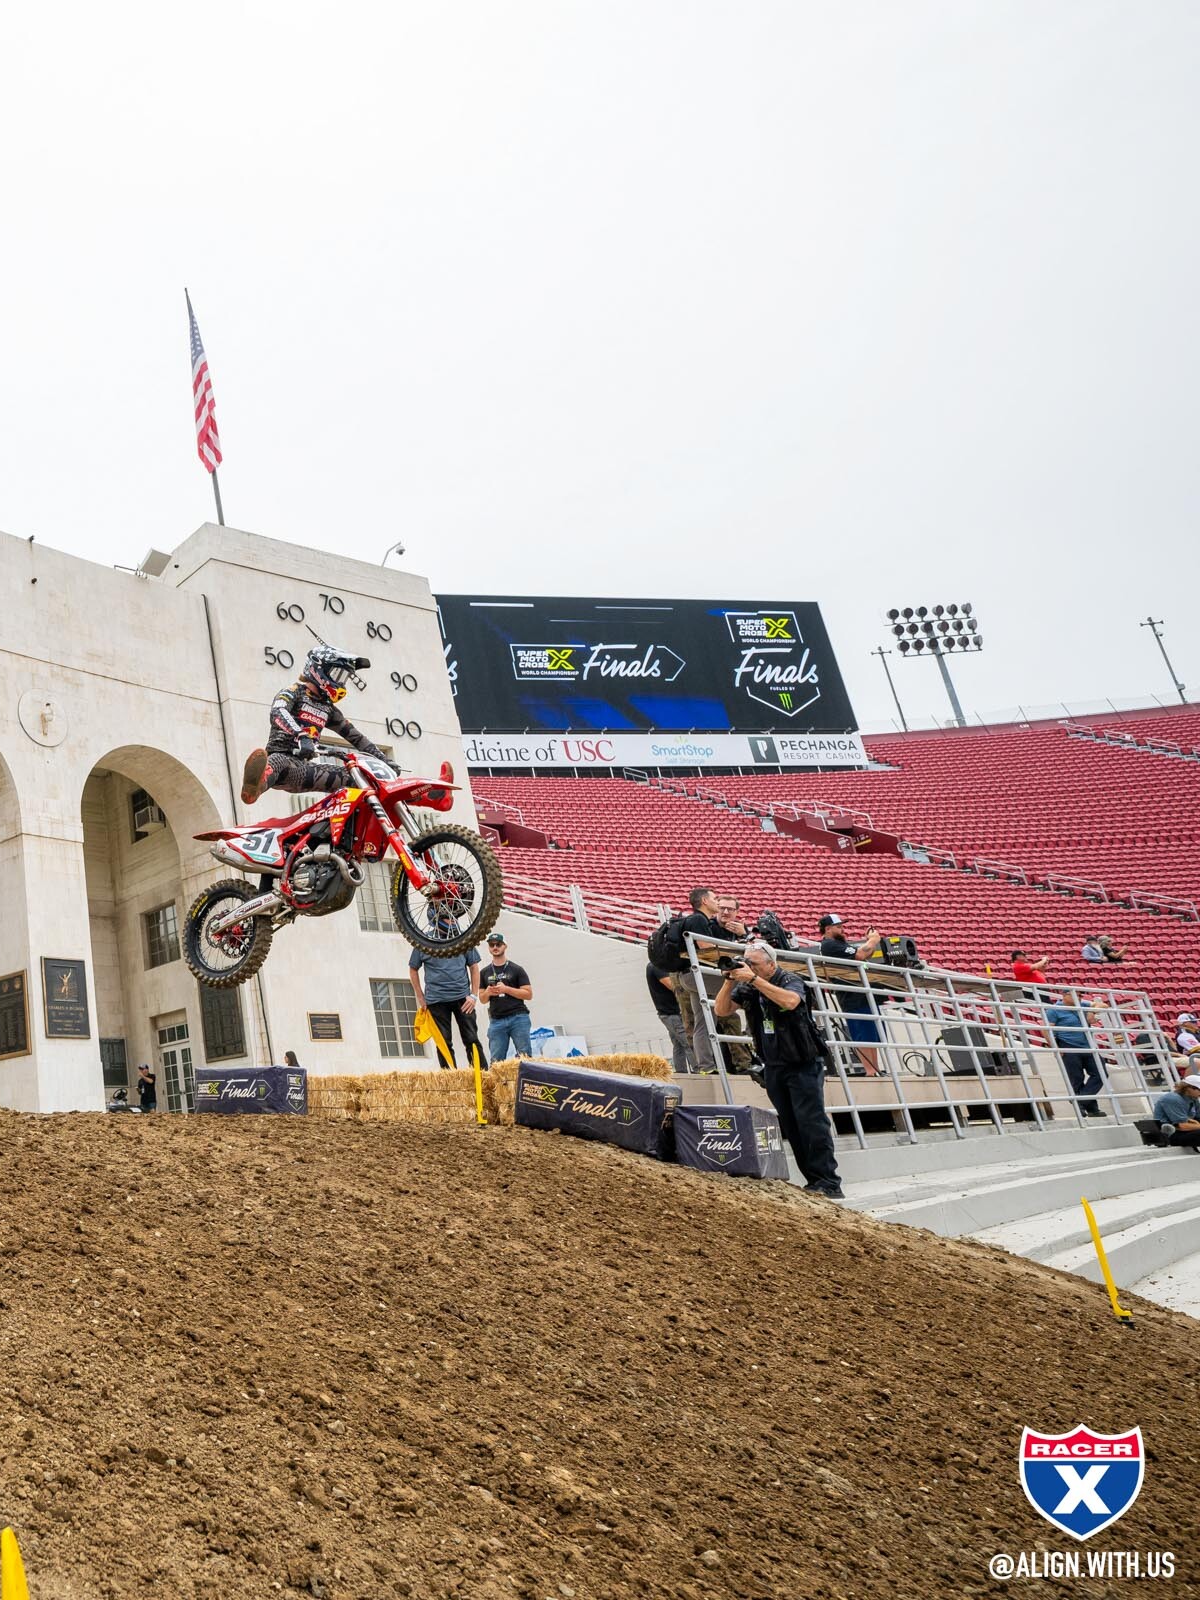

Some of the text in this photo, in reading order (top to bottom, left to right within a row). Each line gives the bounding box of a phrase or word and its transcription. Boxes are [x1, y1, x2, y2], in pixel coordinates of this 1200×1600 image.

[276, 602, 304, 622] 60
[319, 593, 345, 614] 70
[367, 621, 392, 641] 80
[264, 646, 294, 669] 50
[582, 643, 661, 680] Finals
[734, 647, 819, 687] Finals
[390, 671, 418, 692] 90
[385, 717, 422, 740] 100
[535, 739, 558, 761] of
[560, 739, 616, 762] USC
[651, 744, 714, 757] SmartStop
[780, 740, 857, 751] PECHANGA
[299, 802, 352, 823] GASGAS
[242, 831, 275, 854] 51
[220, 1079, 257, 1100] Finals
[560, 1088, 618, 1120] Finals
[697, 1132, 742, 1151] Finals
